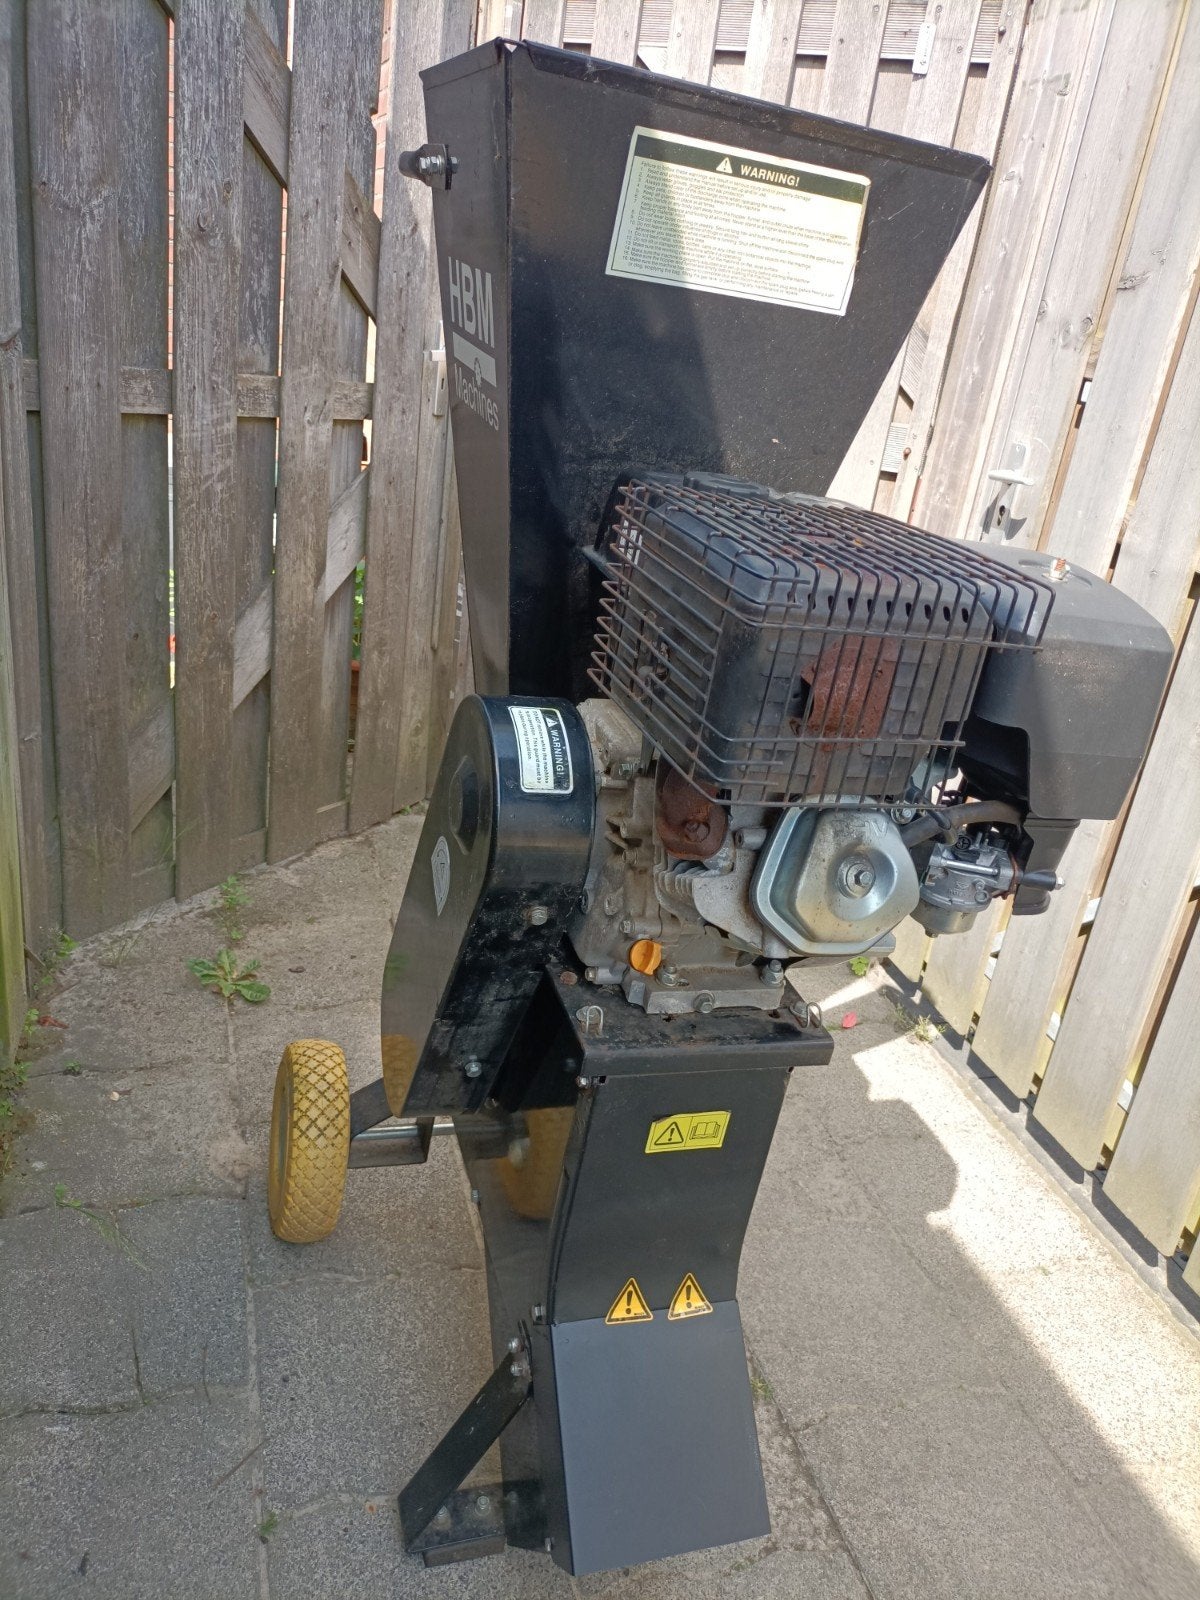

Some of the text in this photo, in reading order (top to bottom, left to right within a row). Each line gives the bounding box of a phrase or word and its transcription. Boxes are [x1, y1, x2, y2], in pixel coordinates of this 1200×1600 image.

[740, 164, 800, 187] WARNING!
[448, 256, 495, 348] HBM
[454, 363, 499, 431] Machines
[550, 730, 564, 775] WARNING!
